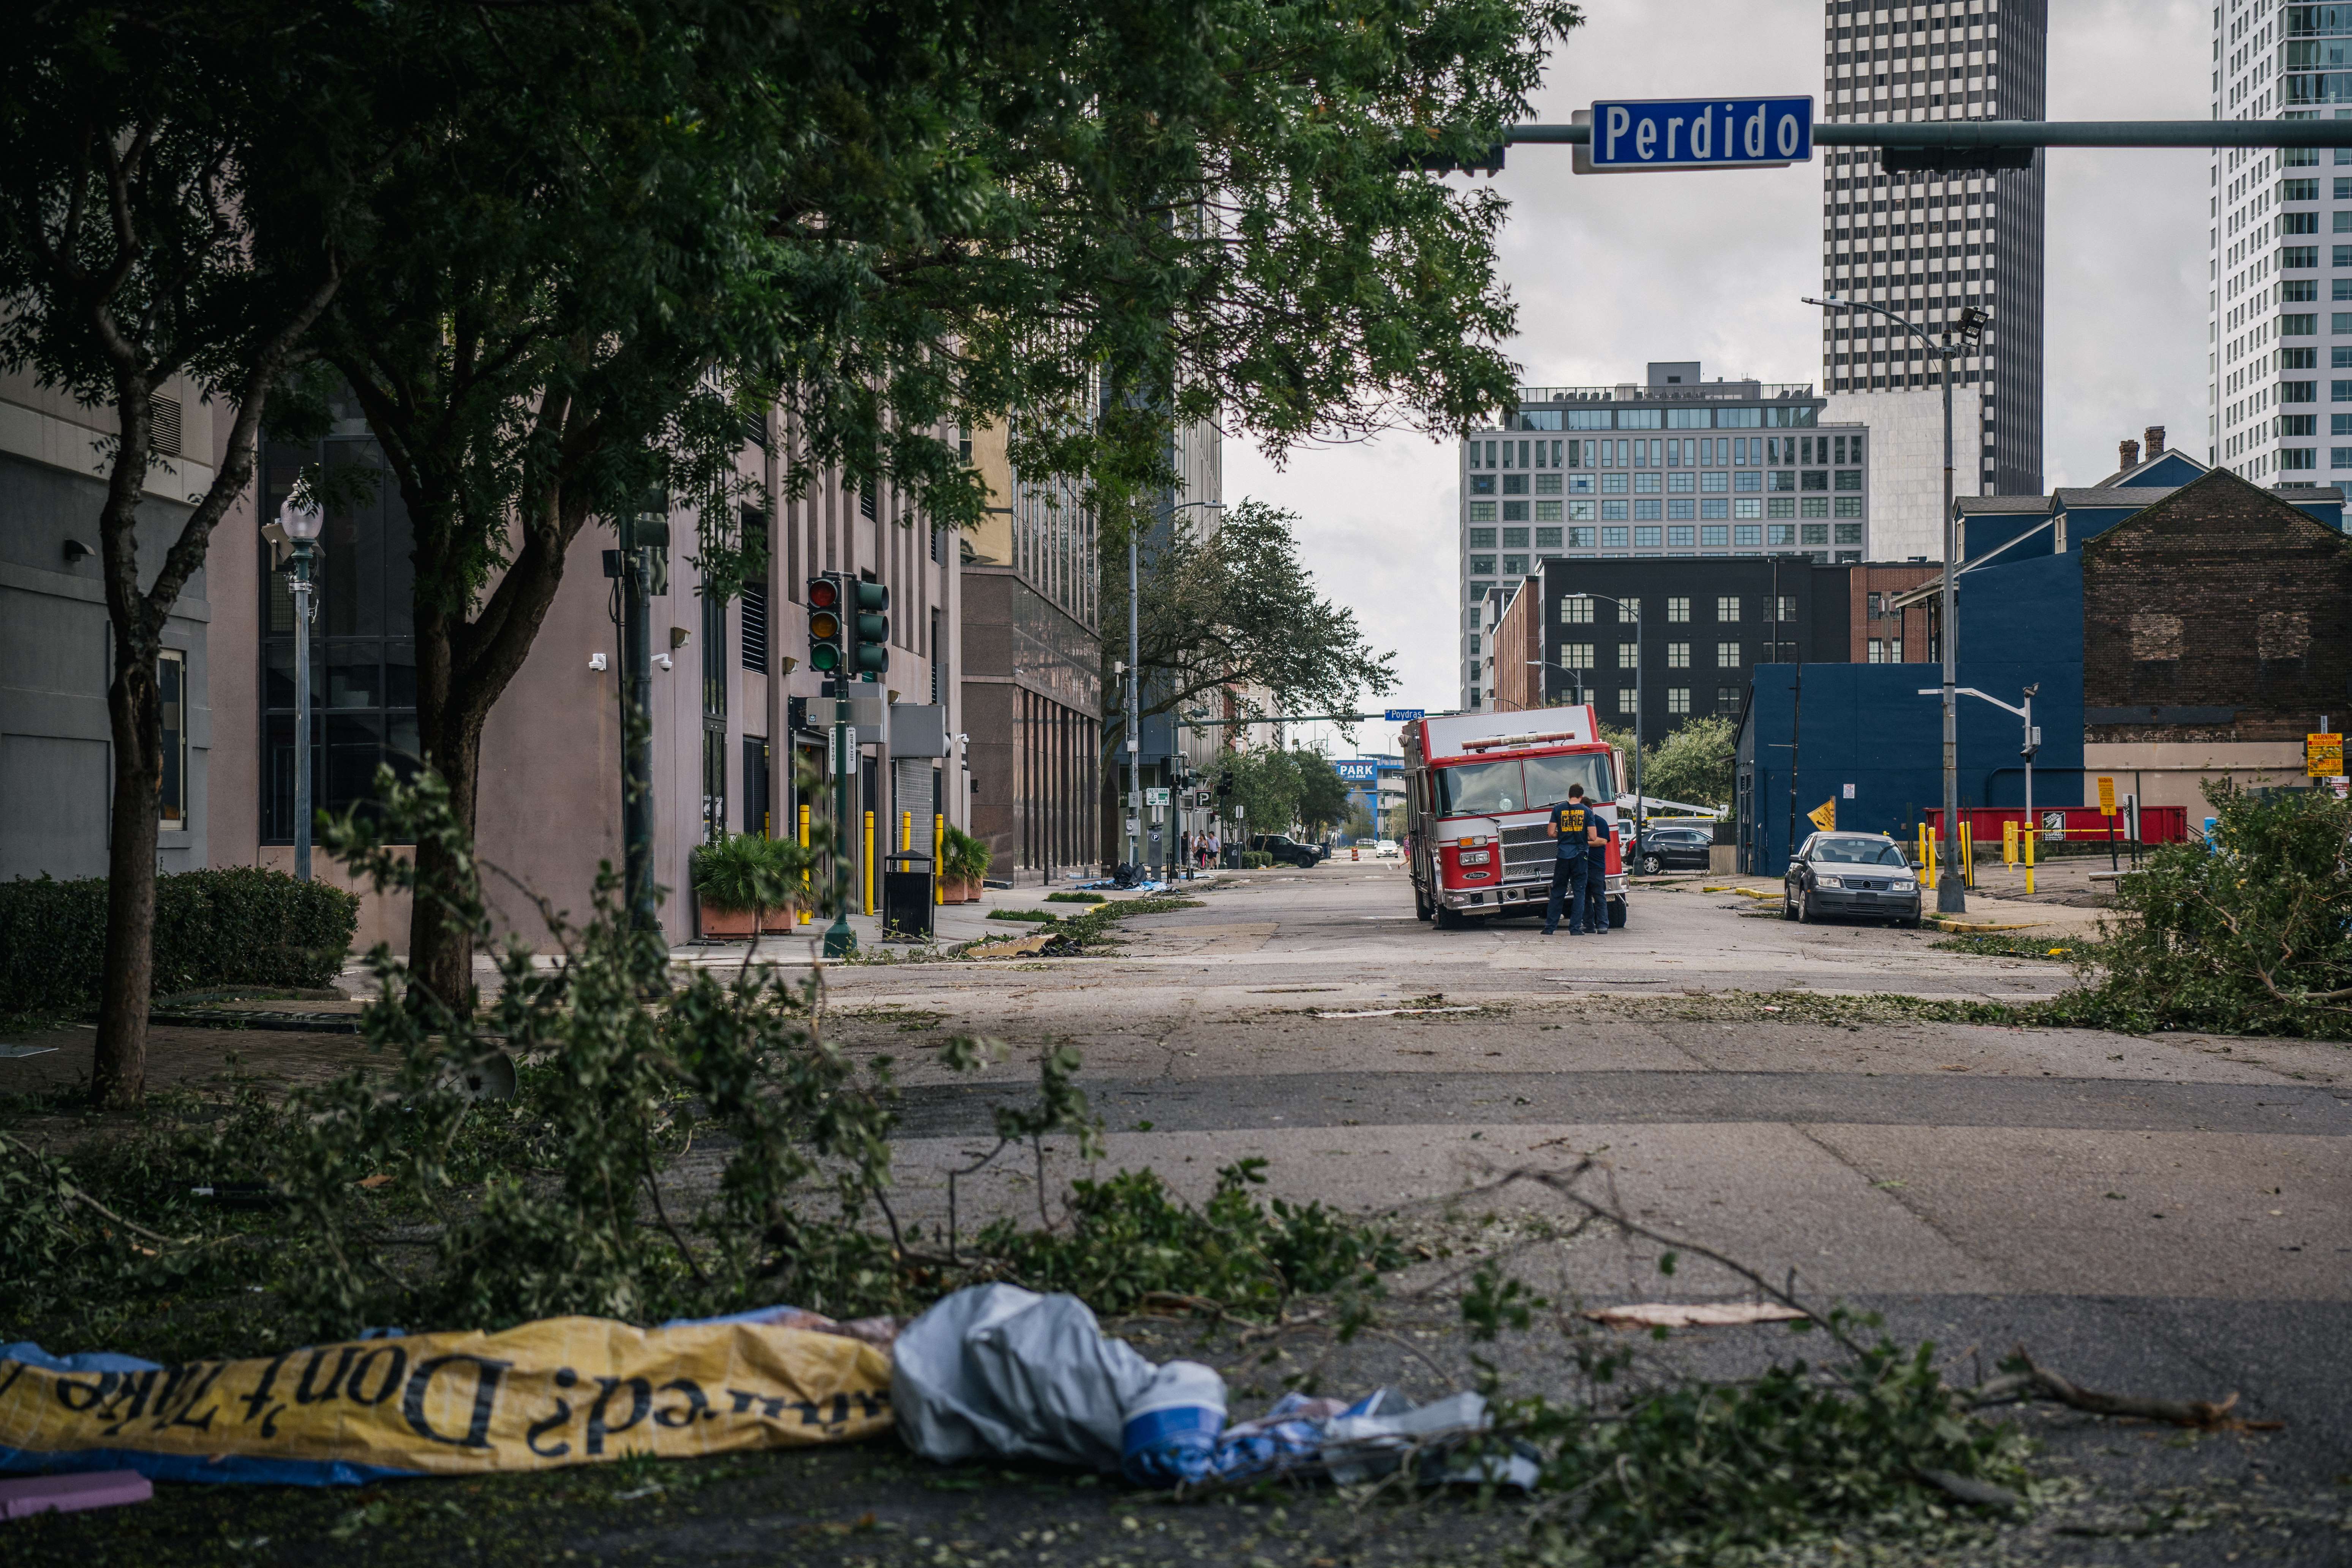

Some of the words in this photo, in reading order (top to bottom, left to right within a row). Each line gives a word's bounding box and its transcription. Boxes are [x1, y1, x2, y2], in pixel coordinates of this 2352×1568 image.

[1606, 103, 1799, 160] Perdido
[1392, 710, 1422, 720] Poydras
[1340, 765, 1373, 775] PARK
[1200, 793, 1209, 805] P
[1561, 814, 1584, 827] FIRE
[243, 1345, 514, 1449] Don't
